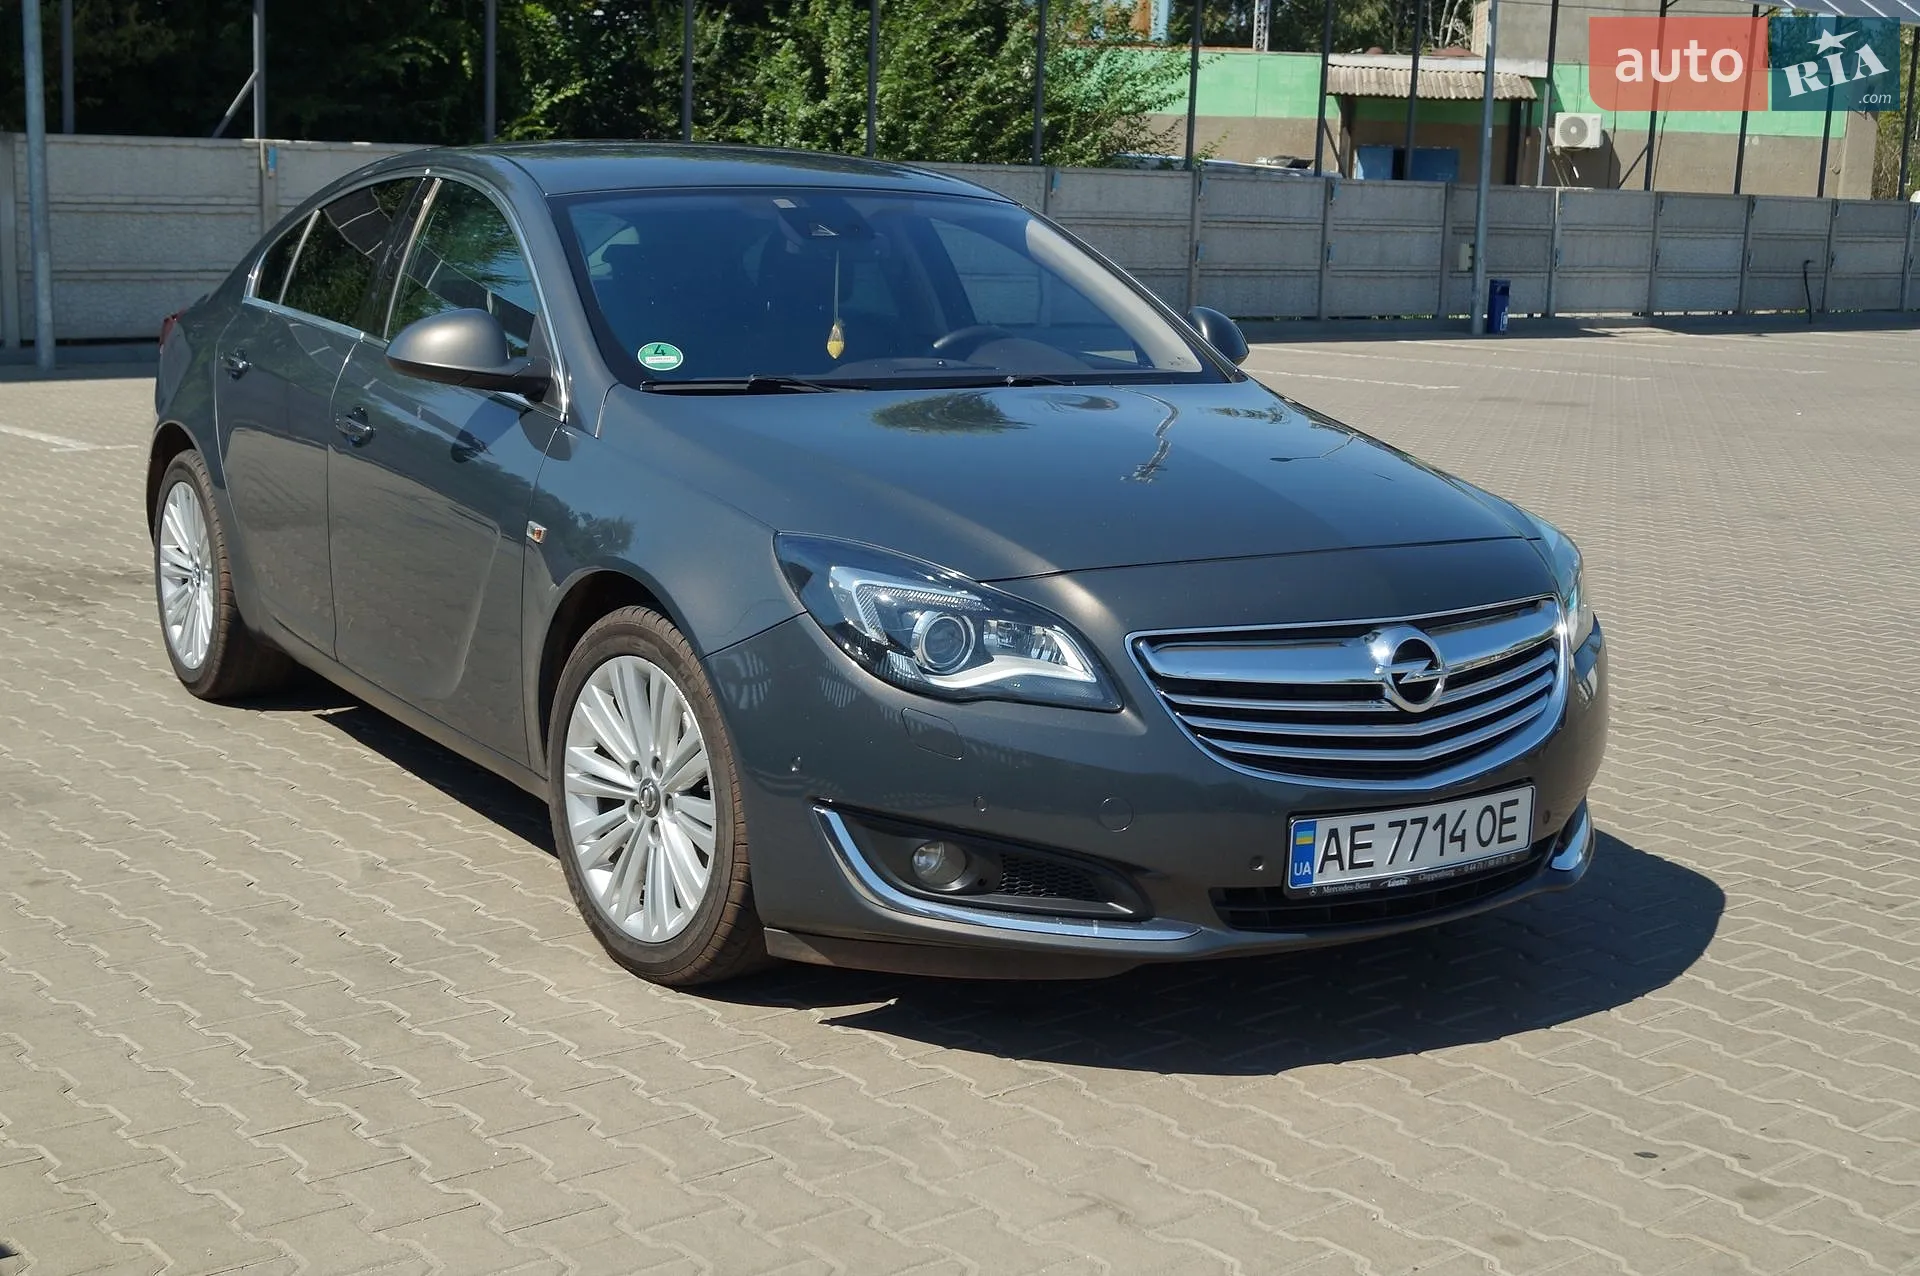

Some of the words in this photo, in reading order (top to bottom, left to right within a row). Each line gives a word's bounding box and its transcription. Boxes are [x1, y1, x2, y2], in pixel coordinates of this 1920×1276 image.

[653, 344, 666, 356] 4
[1317, 823, 1376, 874] AE
[1385, 809, 1468, 865] 7714
[1476, 798, 1520, 848] OE
[1293, 861, 1312, 877] UA
